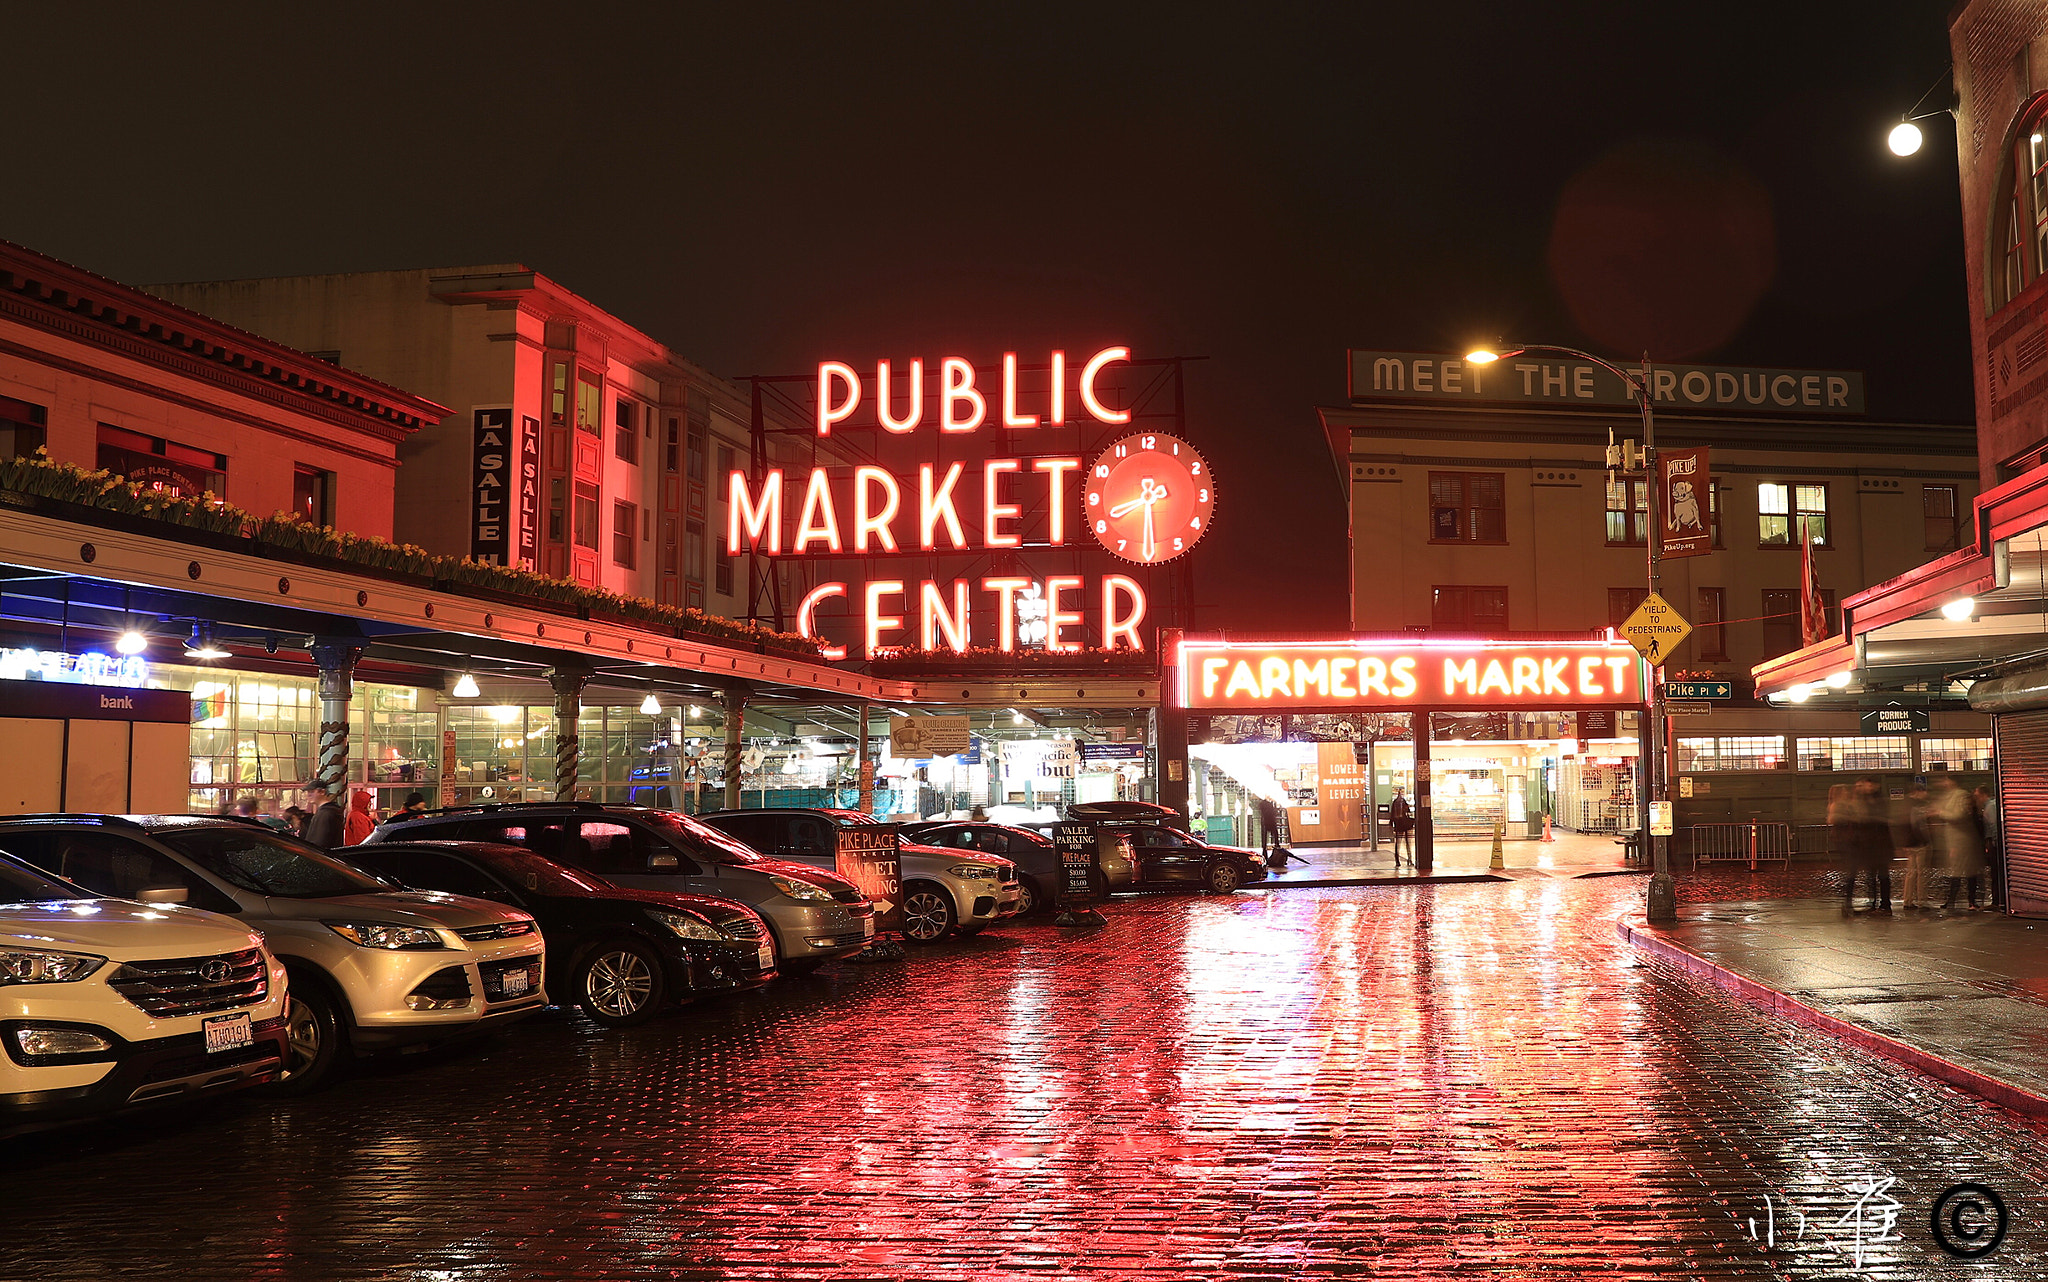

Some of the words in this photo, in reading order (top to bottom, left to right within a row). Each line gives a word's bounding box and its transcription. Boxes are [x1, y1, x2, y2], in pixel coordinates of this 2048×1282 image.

[1373, 357, 1488, 395] MEET
[1515, 363, 1595, 398] THE
[817, 345, 1133, 438] PUBLIC
[479, 414, 503, 447] LA
[524, 419, 537, 455] LA
[1141, 435, 1156, 450] 12
[1173, 442, 1179, 456] 1
[1115, 444, 1127, 458] 11
[1095, 464, 1110, 478] 10
[1191, 461, 1201, 475] 2
[1669, 461, 1684, 475] PIKE
[1684, 457, 1697, 473] UP!
[129, 467, 146, 480] PIKE
[148, 466, 170, 477] PLACE
[172, 471, 196, 493] DENTAL
[477, 454, 503, 541] SALLE
[1088, 492, 1100, 506] 9
[1199, 488, 1208, 503] 3
[521, 462, 536, 548] SALLE
[727, 456, 1083, 557] MARKET
[1095, 519, 1107, 534] 8
[1190, 516, 1201, 530] 4
[1117, 539, 1127, 552] 7
[1173, 537, 1183, 551] 5
[1664, 543, 1695, 552] PikeUp.org
[1643, 605, 1667, 614] YIELD
[796, 574, 1147, 661] CENTER
[1649, 615, 1660, 624] TO
[1627, 624, 1682, 634] PEDESTRIANS
[1202, 656, 1417, 699] FARMERS
[1443, 656, 1631, 696] MARKET
[1669, 683, 1695, 696] Pike
[100, 694, 133, 709] bank
[1879, 710, 1909, 720] CORNER
[1877, 720, 1912, 732] PRODUCE
[1330, 764, 1357, 775] LOWER
[1329, 788, 1360, 800] LEVELS
[1061, 826, 1089, 835] VALET
[838, 832, 860, 849] PIKE
[862, 833, 895, 849] PLACE
[1056, 835, 1095, 844] PARKING
[1062, 852, 1074, 863] PIKE
[1074, 852, 1091, 863] PLACE
[841, 860, 897, 878] VALET
